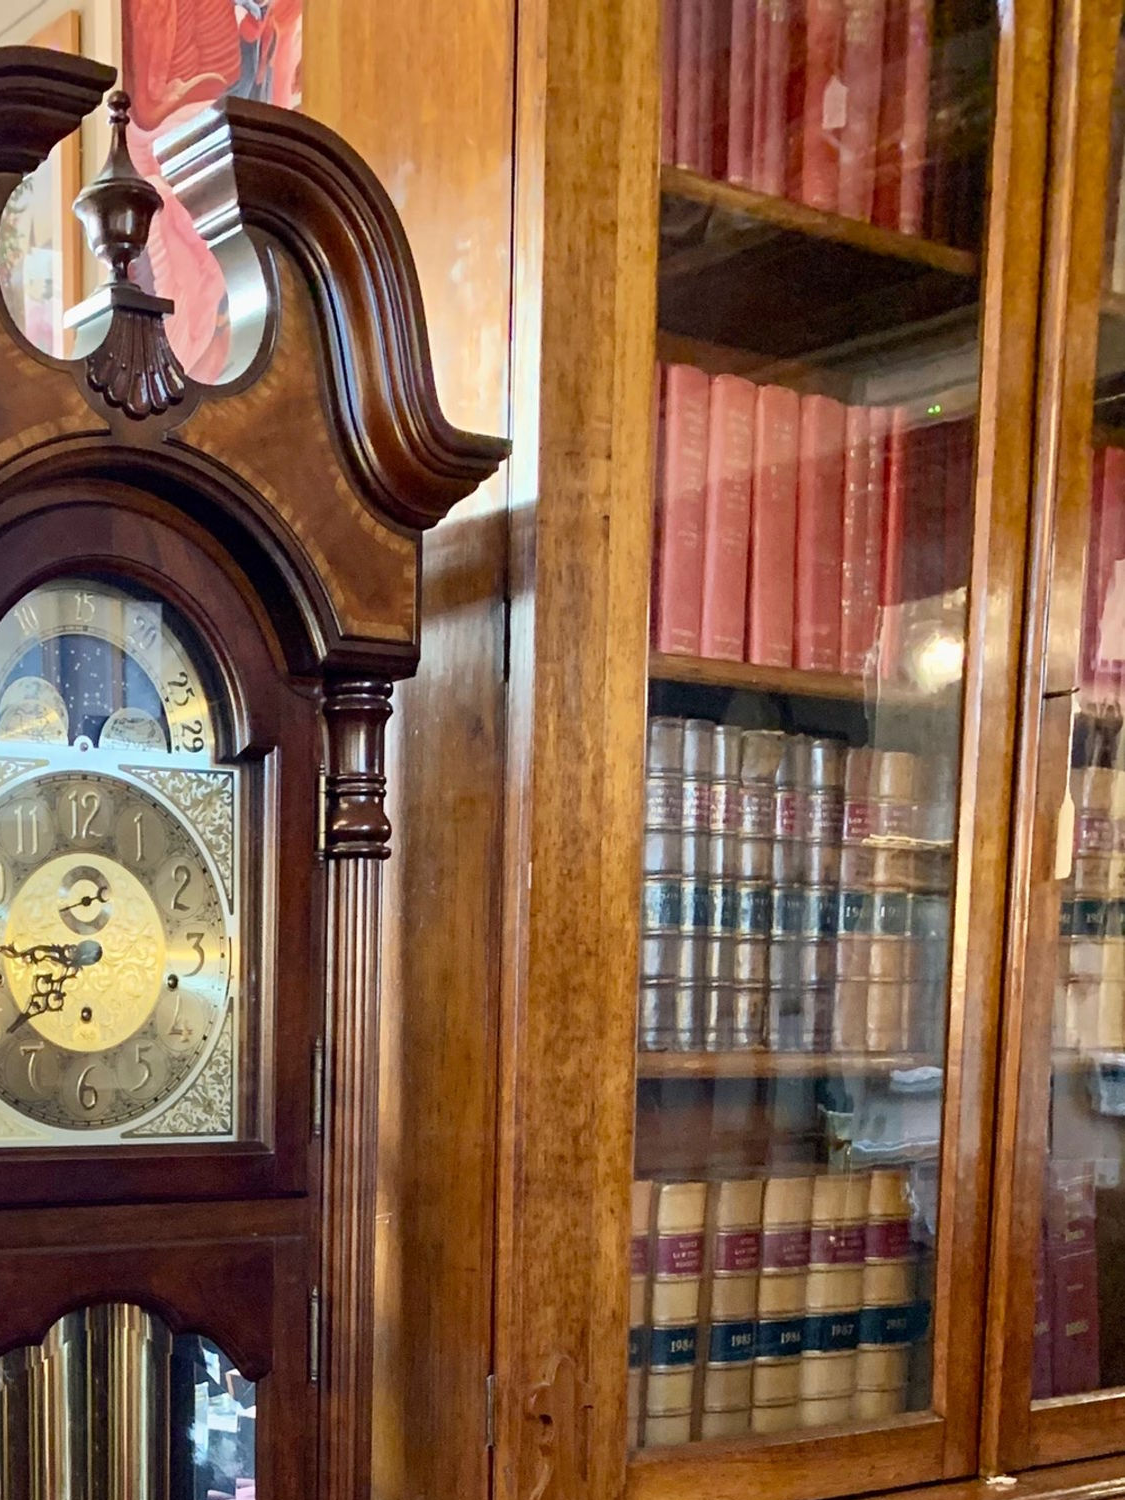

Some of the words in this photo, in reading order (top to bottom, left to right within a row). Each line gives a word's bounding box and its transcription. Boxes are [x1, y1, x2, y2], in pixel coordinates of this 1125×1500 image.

[13, 605, 41, 637] 10
[74, 591, 96, 623] 15
[125, 614, 158, 651] 20
[167, 671, 196, 707] 25
[181, 719, 205, 754] 29
[13, 804, 39, 856] 11
[68, 789, 103, 840] 12
[132, 811, 144, 863] 1
[172, 864, 192, 911] 2
[183, 931, 205, 978] 3
[168, 992, 193, 1044] 4
[19, 1041, 45, 1095] 7
[76, 1064, 98, 1111] 6
[129, 1043, 154, 1093] 5
